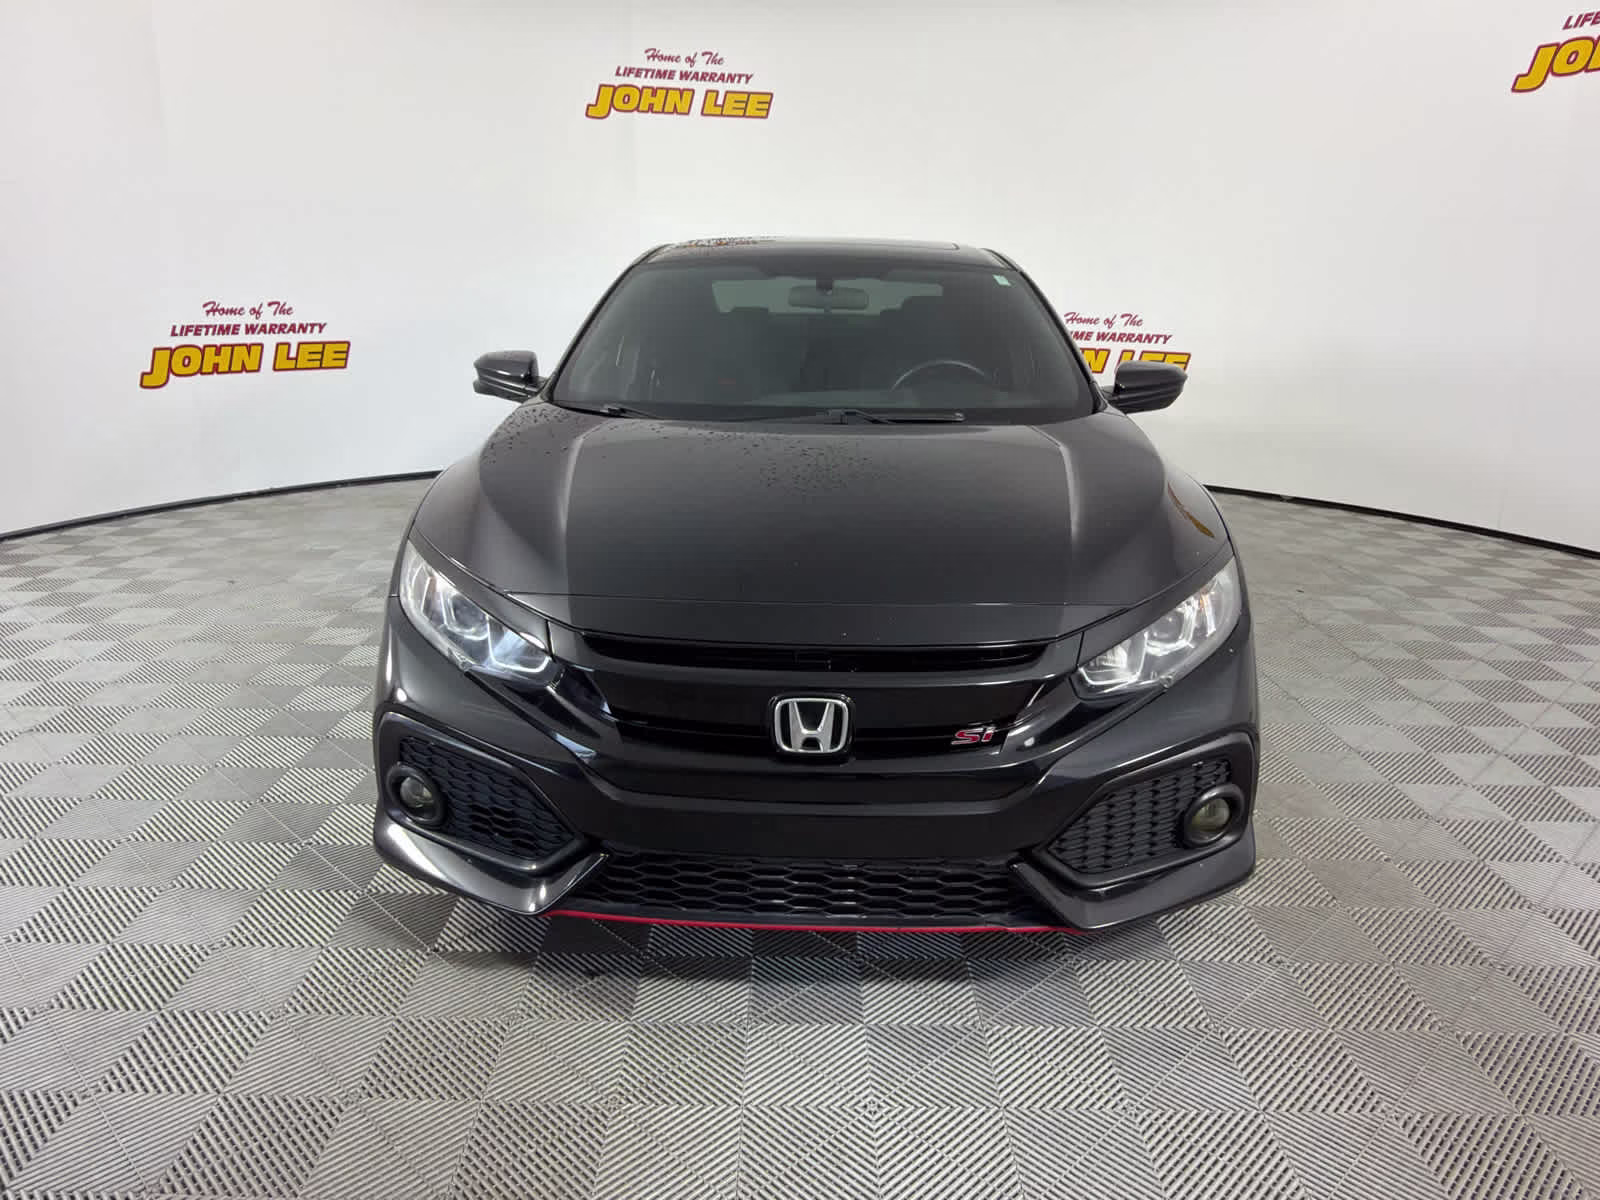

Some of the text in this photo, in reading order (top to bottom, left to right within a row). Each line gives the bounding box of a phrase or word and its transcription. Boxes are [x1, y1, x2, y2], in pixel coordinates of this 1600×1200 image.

[644, 48, 724, 67] Home of The
[615, 66, 753, 84] LIFETIME WARRANTY
[585, 84, 774, 119] JOHN LEE
[202, 301, 293, 319] Home of The
[1064, 311, 1143, 328] Home of The
[170, 322, 327, 337] LIFETIME WARRANTY
[1096, 332, 1173, 345] WARRANTY
[139, 341, 351, 389] JOHN LEE
